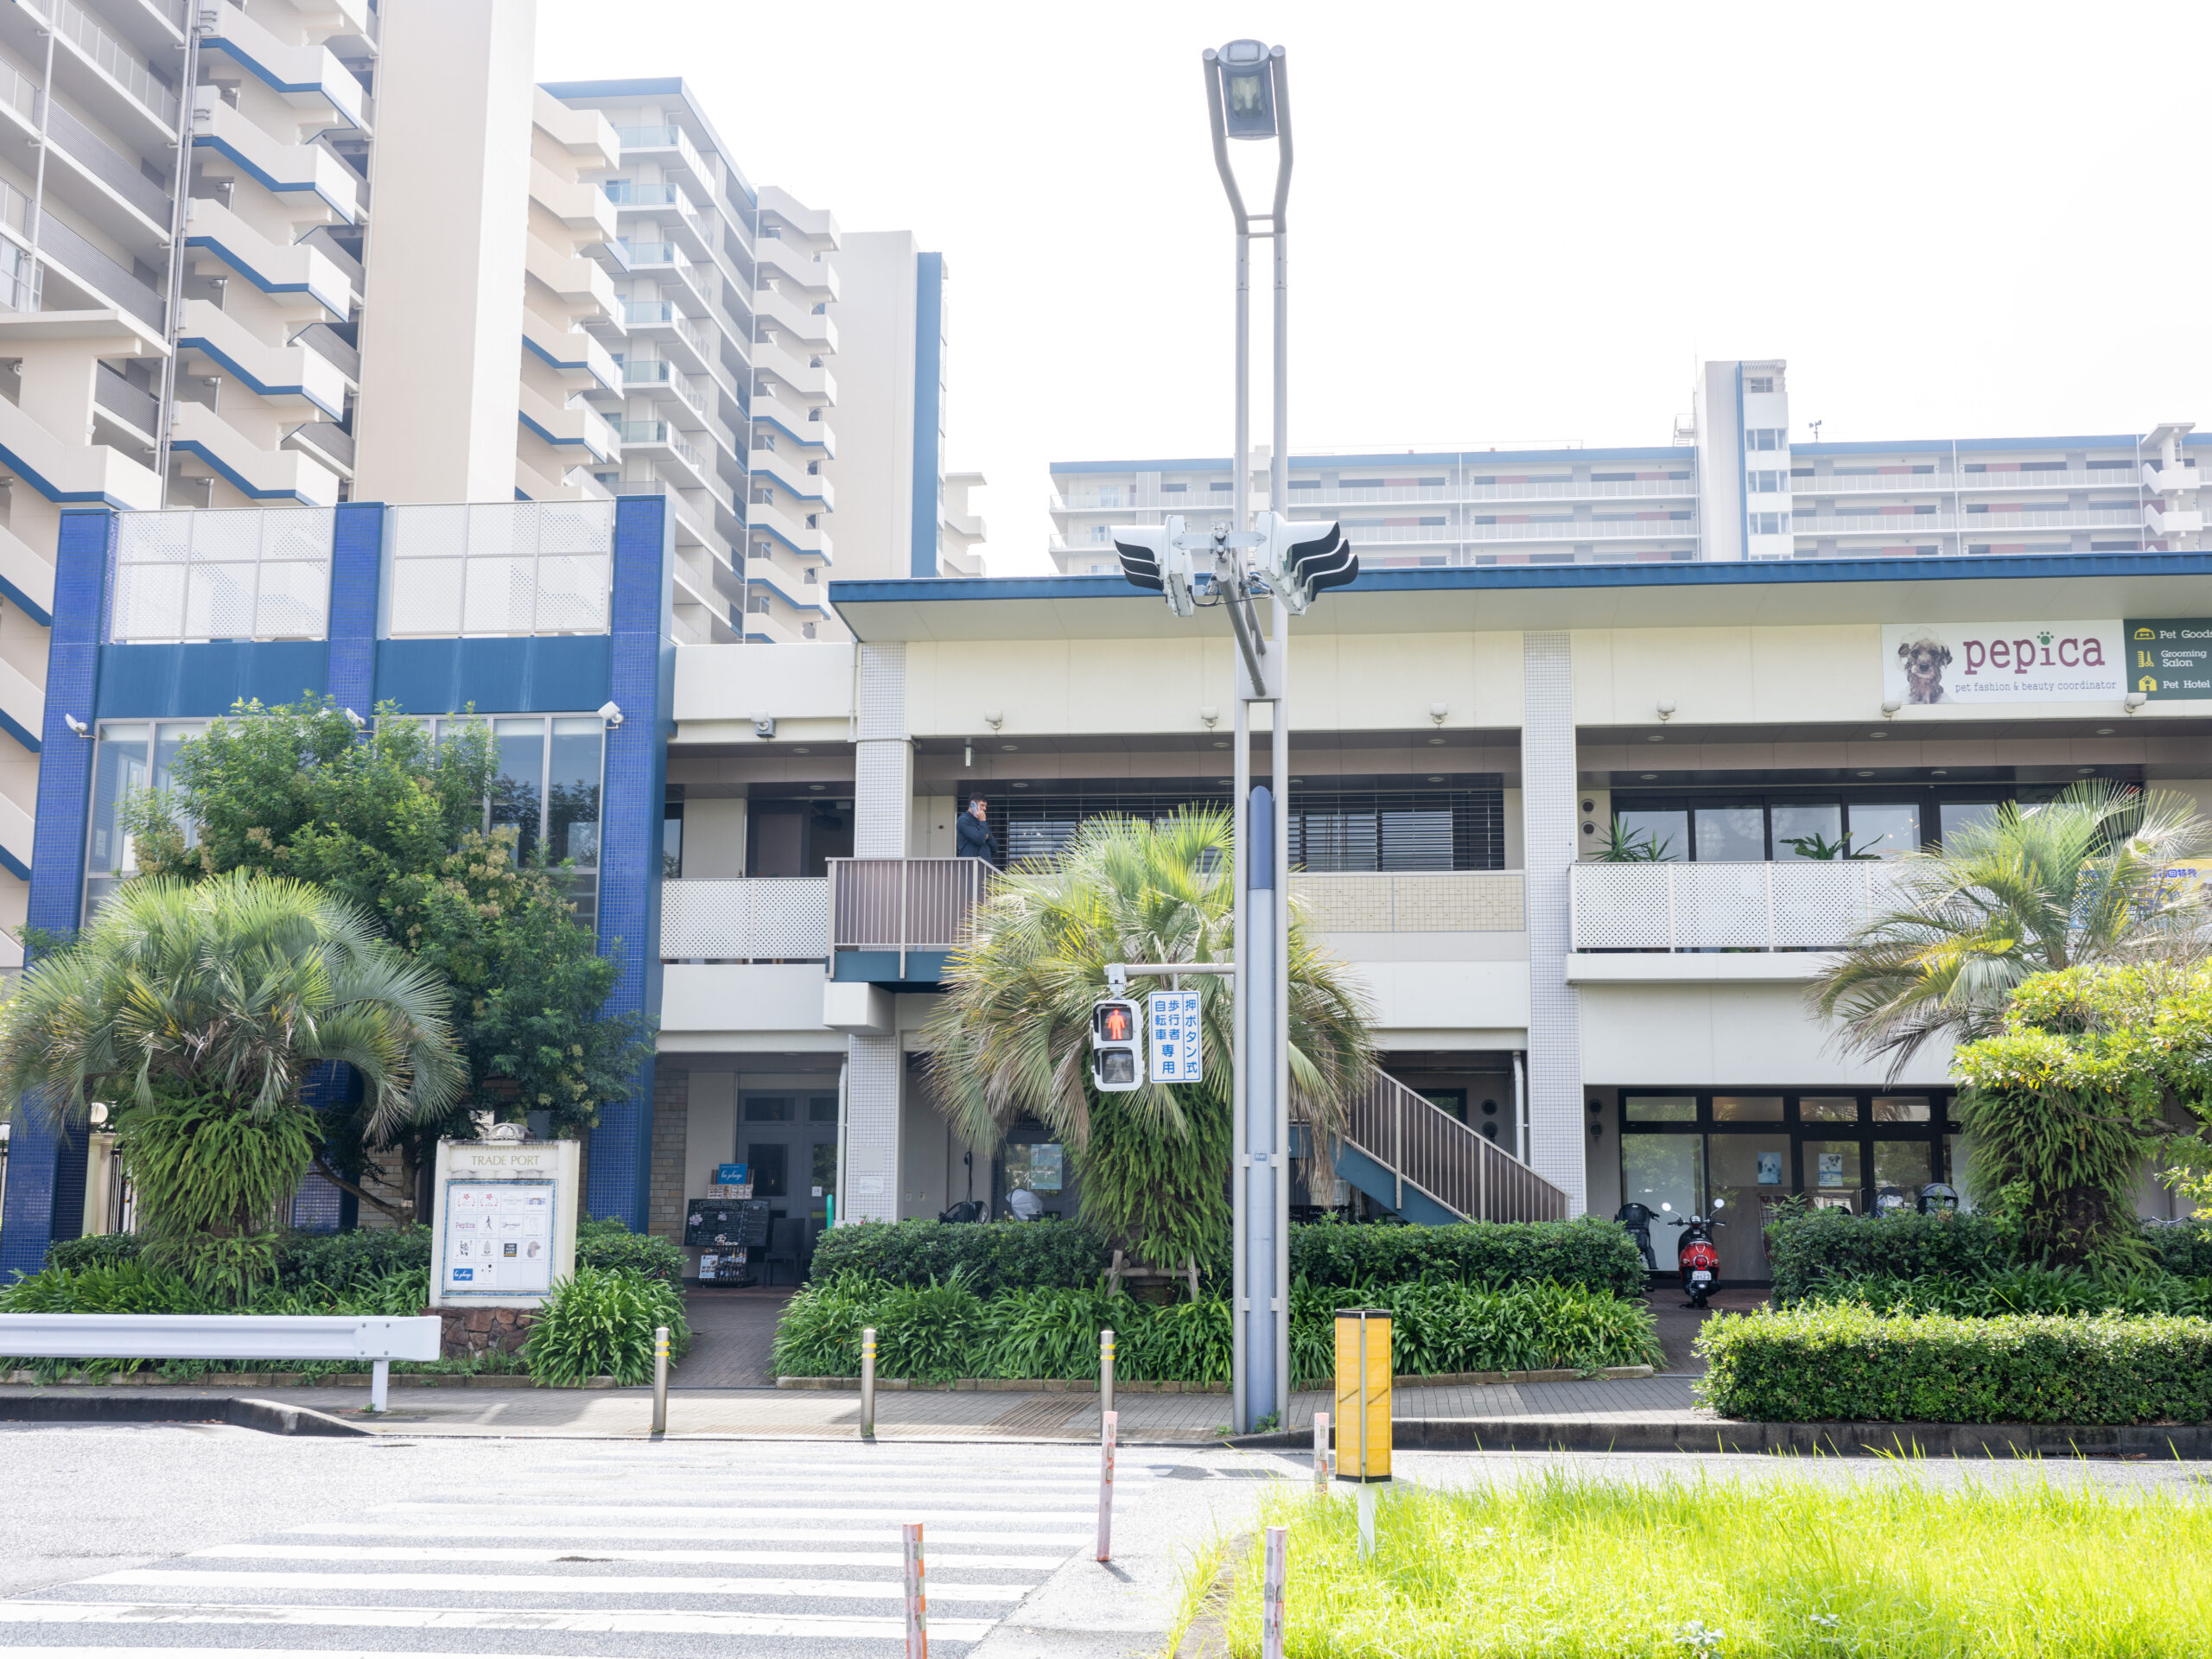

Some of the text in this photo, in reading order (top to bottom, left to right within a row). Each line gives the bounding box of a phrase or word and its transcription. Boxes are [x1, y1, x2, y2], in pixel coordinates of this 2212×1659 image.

[2159, 630, 2177, 639] Pet
[1963, 632, 2106, 675] pepica
[2161, 650, 2207, 658] Grooming
[2163, 658, 2193, 667] Salon
[1955, 681, 2117, 693] pet fashion & beauty coordinator
[2163, 680, 2179, 689] Pet
[1154, 1001, 1166, 1040] 自転車
[1168, 1000, 1180, 1040] 歩行者
[1185, 999, 1198, 1074] 押ボタン式
[1161, 1044, 1175, 1075] 専用
[471, 1155, 540, 1166] TRADE PORT
